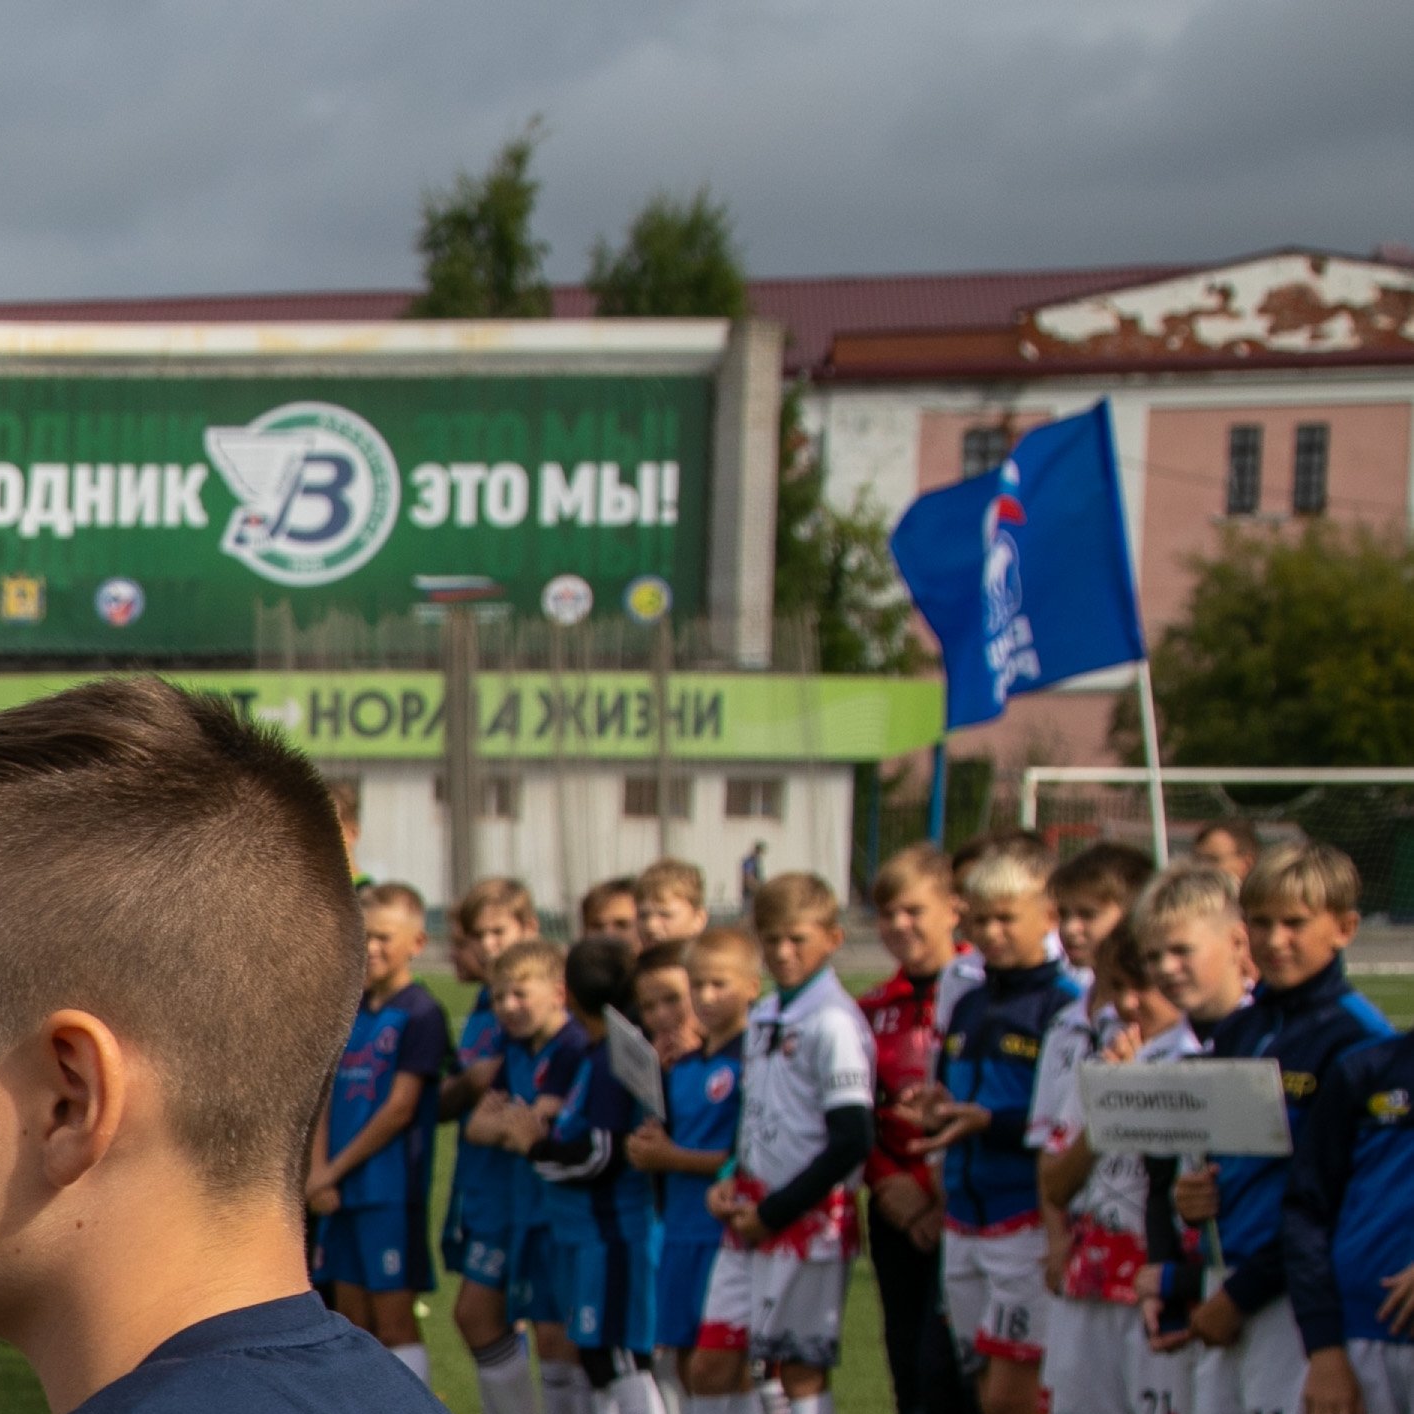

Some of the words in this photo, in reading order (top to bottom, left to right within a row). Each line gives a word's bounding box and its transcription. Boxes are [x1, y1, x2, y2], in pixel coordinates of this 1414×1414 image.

[408, 462, 528, 528] ЭТО
[539, 460, 680, 527] МЫ!
[307, 688, 521, 740] НОРА
[995, 1301, 1030, 1340] 18
